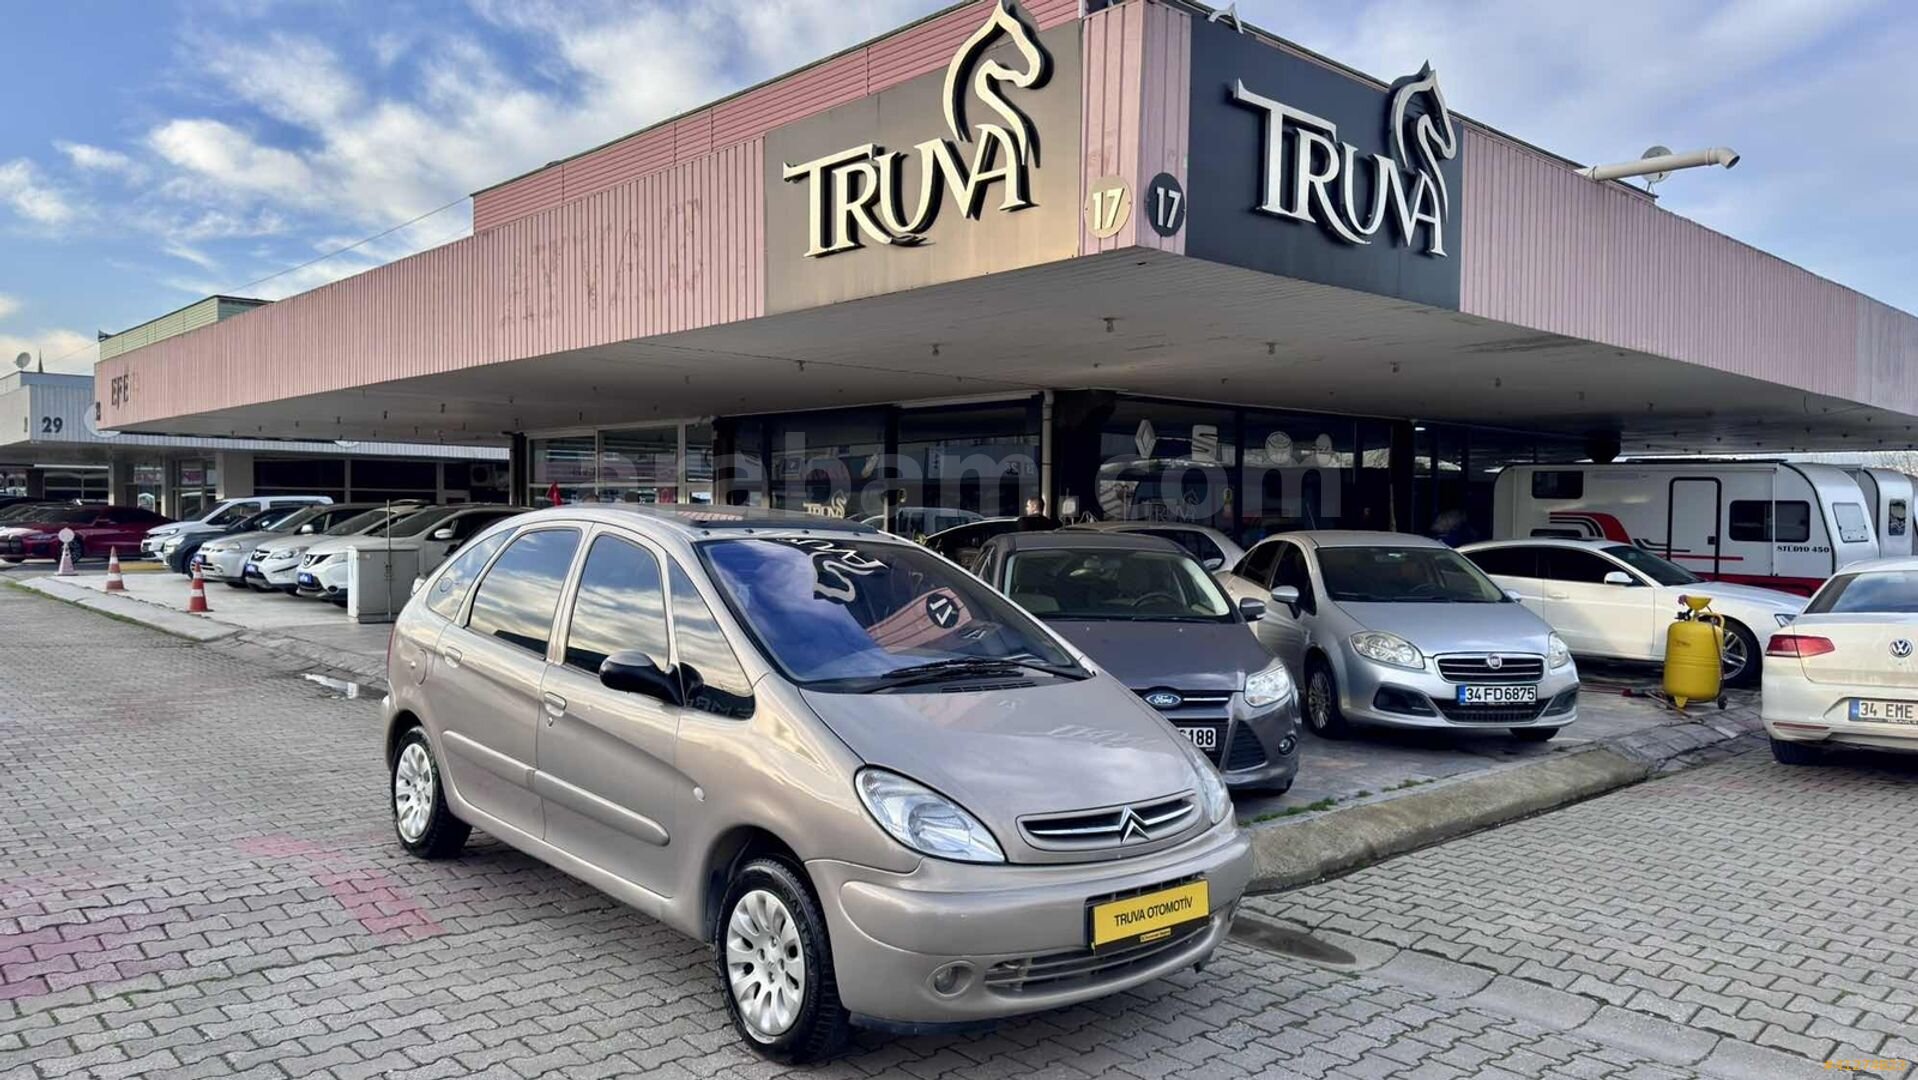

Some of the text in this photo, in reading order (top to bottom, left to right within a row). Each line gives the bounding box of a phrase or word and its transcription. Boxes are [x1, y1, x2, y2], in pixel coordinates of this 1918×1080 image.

[1233, 77, 1452, 258] TRUVA
[783, 120, 1037, 258] TRUVA
[1092, 187, 1125, 230] 17
[1156, 186, 1181, 228] 17
[111, 374, 130, 409] EFE
[42, 416, 63, 433] 29
[1466, 687, 1535, 701] 34 FD 6875
[1860, 702, 1914, 719] 34 EME
[1114, 895, 1193, 927] TRUVA OTOMOTİV
